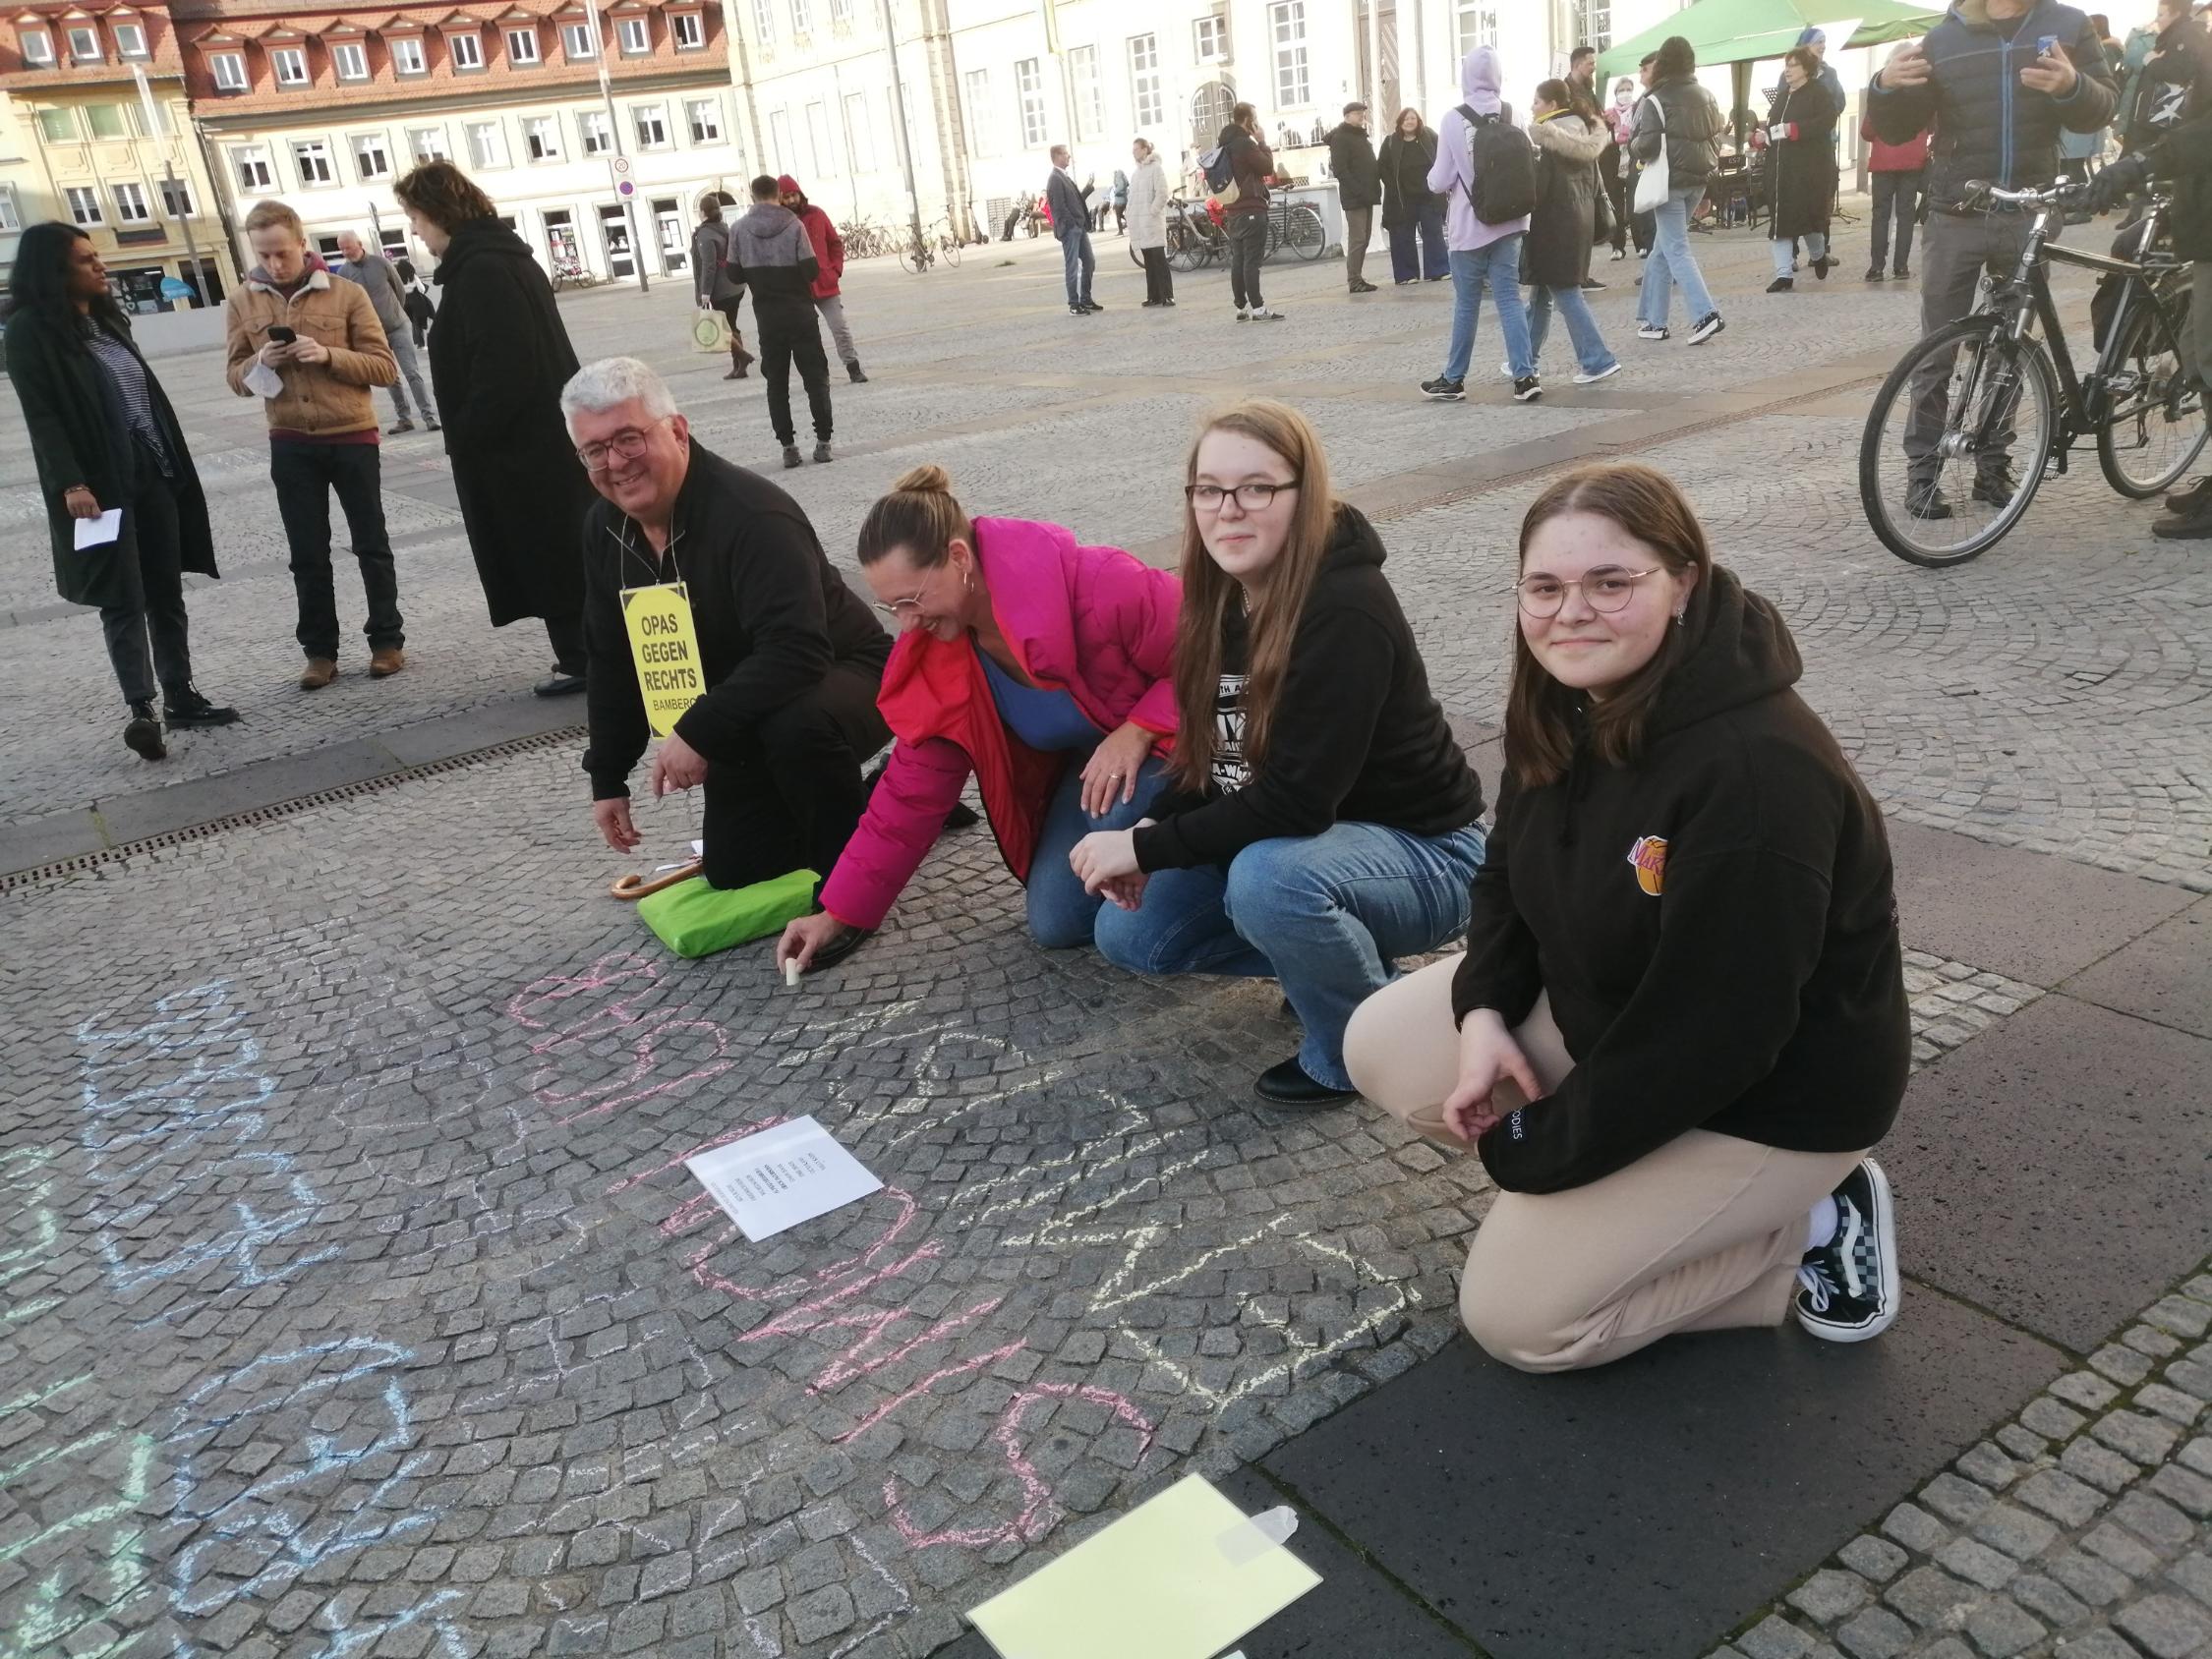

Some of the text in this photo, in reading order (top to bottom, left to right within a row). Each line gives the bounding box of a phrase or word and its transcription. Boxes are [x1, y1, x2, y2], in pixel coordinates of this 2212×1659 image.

[641, 613, 678, 636] OPAS
[642, 640, 688, 663] GEGEN
[644, 667, 697, 691] RECHTS
